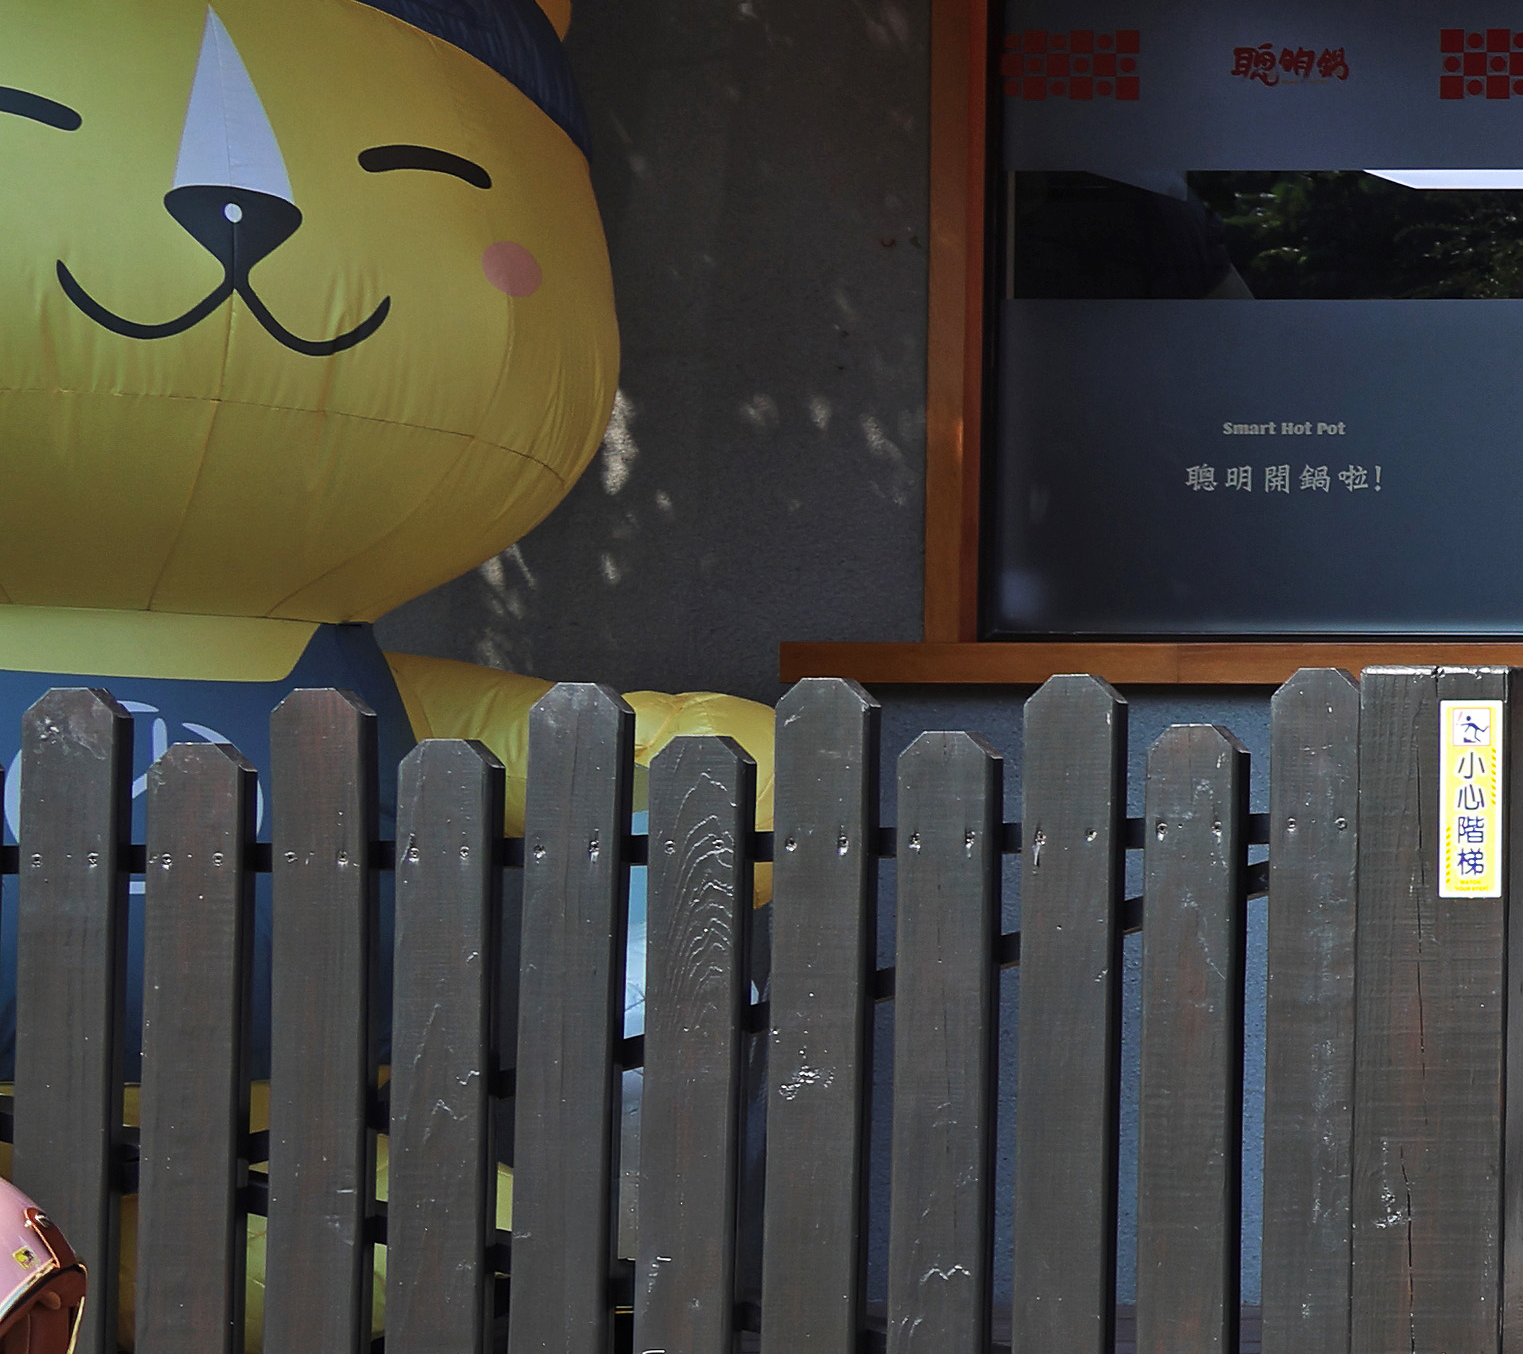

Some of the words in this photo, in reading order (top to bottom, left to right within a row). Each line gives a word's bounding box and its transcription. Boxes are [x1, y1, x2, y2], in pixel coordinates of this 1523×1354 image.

[1223, 422, 1276, 434] Smart
[1281, 422, 1312, 434] Hot
[1317, 422, 1346, 434] Pot
[1185, 463, 1382, 494] 聰明開鍋啦!
[1457, 751, 1485, 875] 小心階梯
